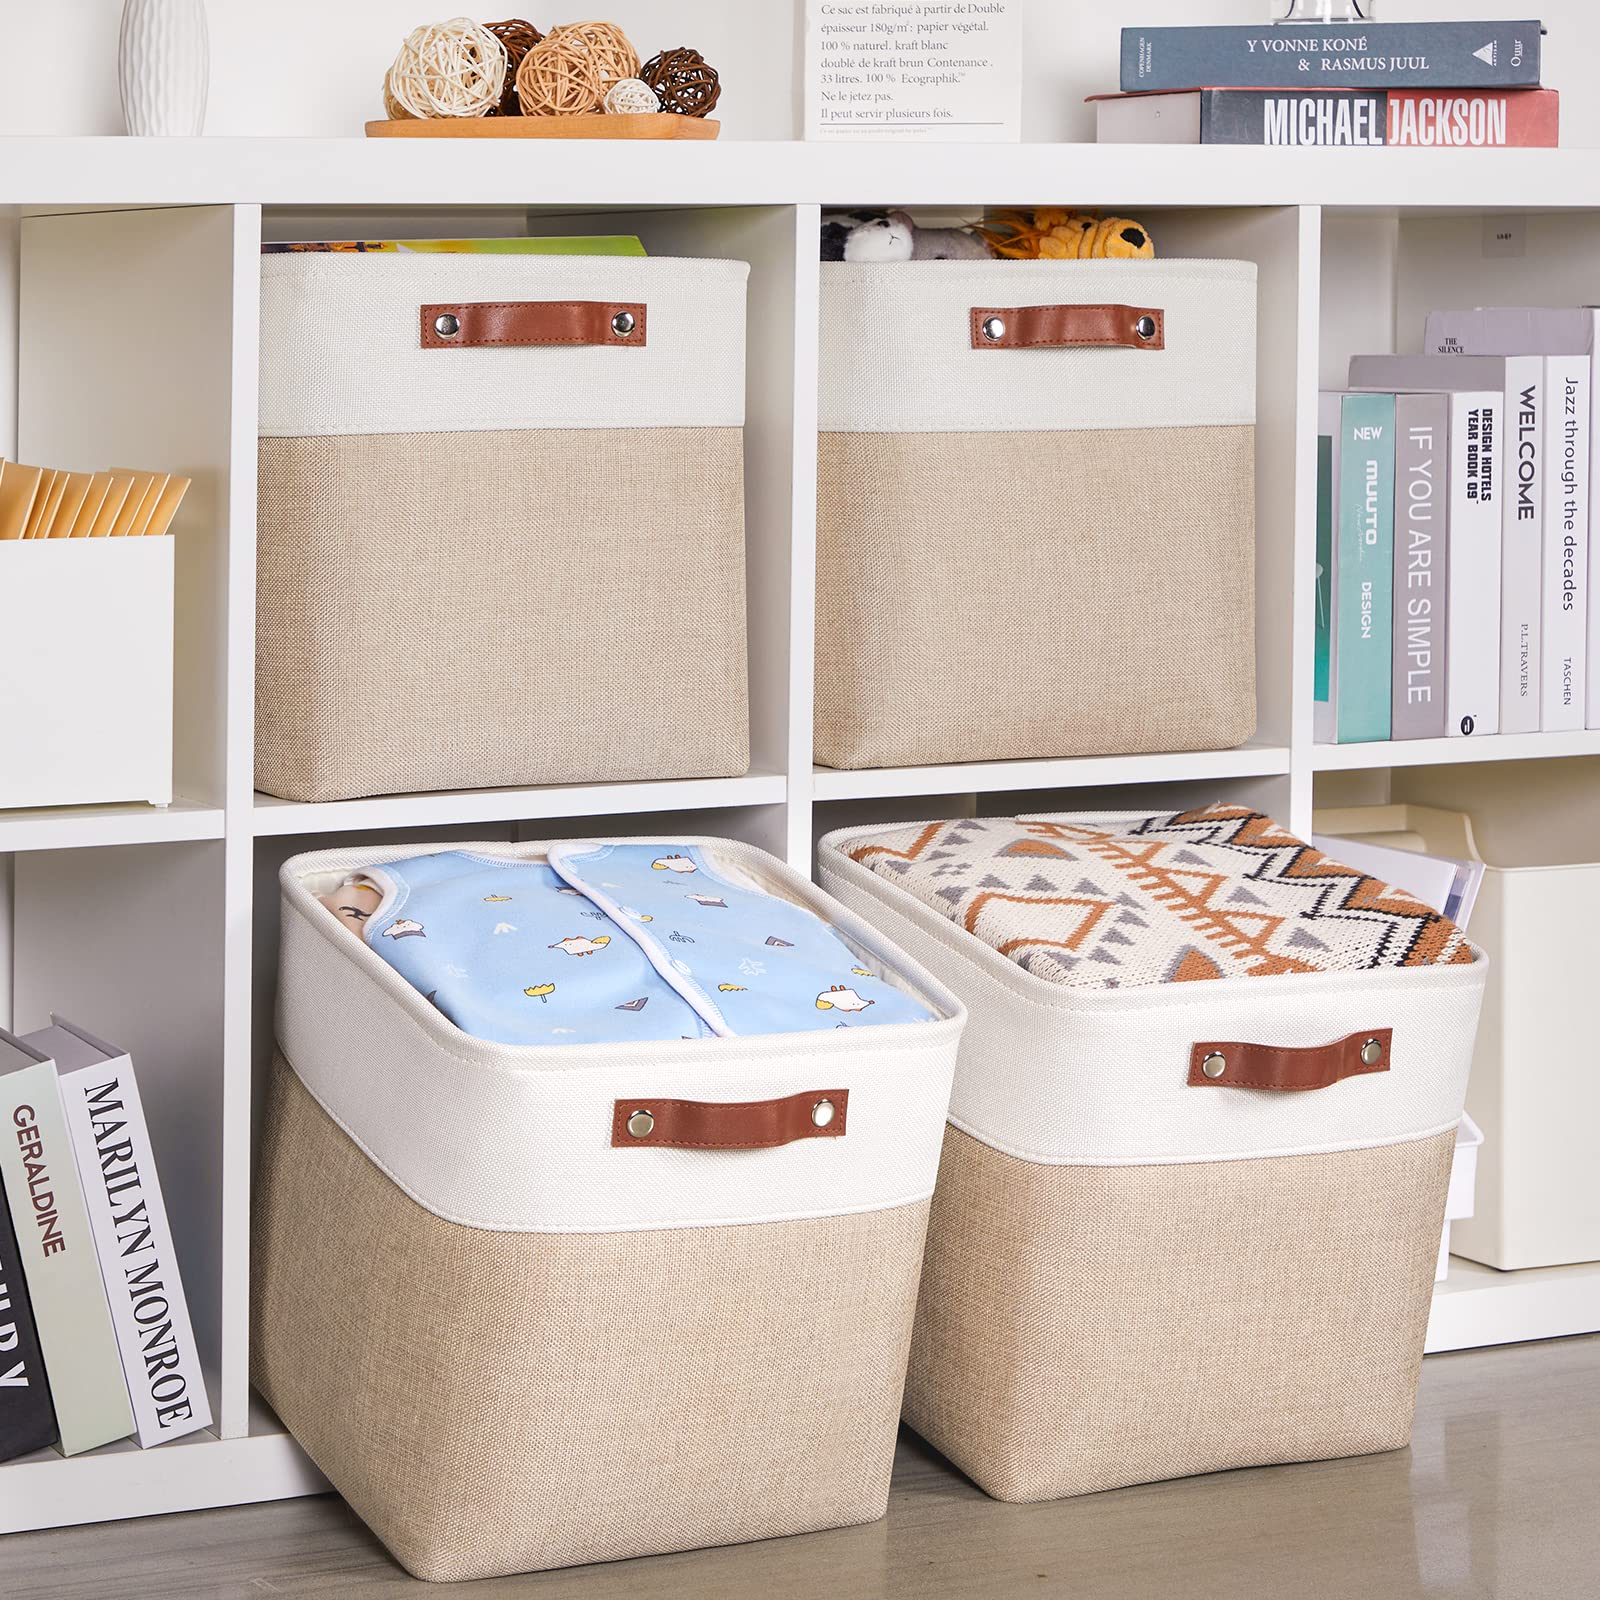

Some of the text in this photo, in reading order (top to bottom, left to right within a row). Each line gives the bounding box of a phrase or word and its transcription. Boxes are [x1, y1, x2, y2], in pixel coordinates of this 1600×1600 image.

[821, 3, 1005, 17] Ce sac est fabriqué à partir de Double
[820, 23, 867, 35] épaisseur
[917, 21, 949, 34] papier
[952, 20, 989, 34] végétal.
[820, 39, 949, 51] 100 % naturel. kraft blanc
[1262, 38, 1319, 52] VONNE
[1323, 36, 1368, 51] KONÉ
[858, 58, 871, 68] de
[873, 57, 897, 68] kraft
[899, 57, 924, 68] brun
[1298, 56, 1430, 72] & RASMUS JUUL
[820, 74, 833, 84] 33
[835, 73, 863, 84] litres.
[866, 73, 884, 83] 100
[885, 73, 896, 83] %
[821, 90, 894, 103] Ne le jetez pas.
[820, 107, 953, 121] Il peut servir plusieurs fois.
[1264, 98, 1506, 146] MICHAEL JACKSON
[1437, 345, 1464, 353] SILENCE
[1444, 337, 1457, 345] THE
[1468, 408, 1480, 441] YEAR
[1353, 426, 1383, 441] NEW
[1481, 408, 1493, 502] DESIGN HOTELS
[1518, 384, 1536, 521] WELCOME
[1467, 444, 1478, 478] BOOK
[1561, 377, 1579, 611] Jazz through the decades
[1407, 426, 1433, 704] IF YOU ARE SIMPLE
[1361, 581, 1372, 639] DESIGN
[1563, 656, 1572, 706] TASCHEN
[13, 1104, 66, 1258] GERALDINE
[83, 1077, 193, 1429] MARILYN MONROE
